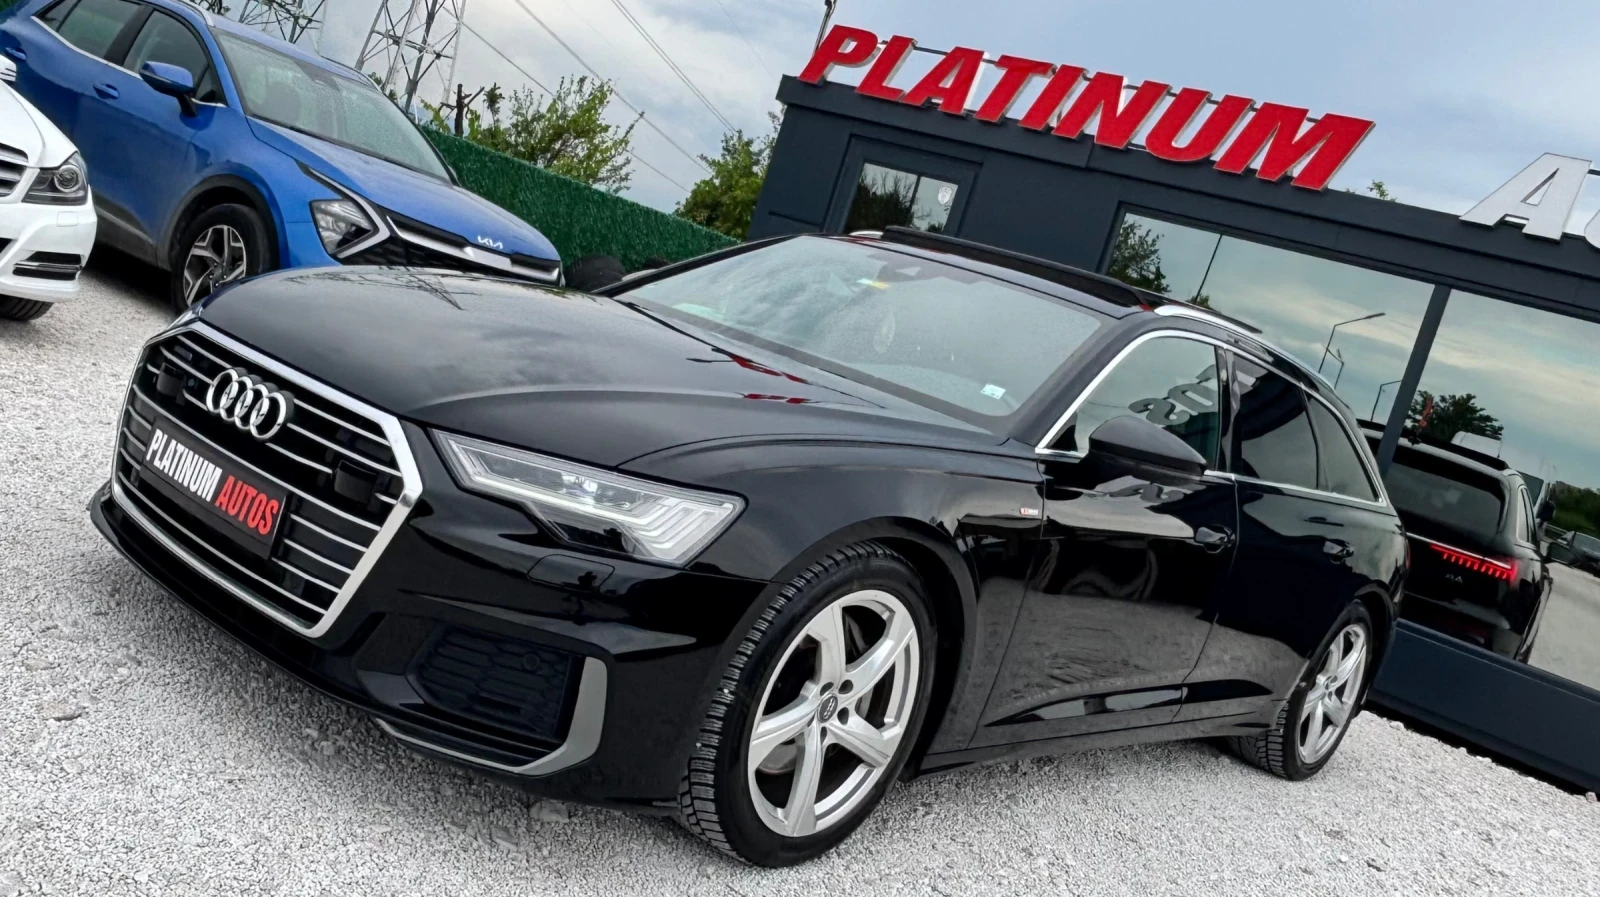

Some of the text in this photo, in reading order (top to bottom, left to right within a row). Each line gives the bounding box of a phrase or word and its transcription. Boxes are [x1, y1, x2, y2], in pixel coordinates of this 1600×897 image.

[797, 24, 1600, 250] PLATINUM A
[146, 428, 279, 535] PLATINUM AUTOS
